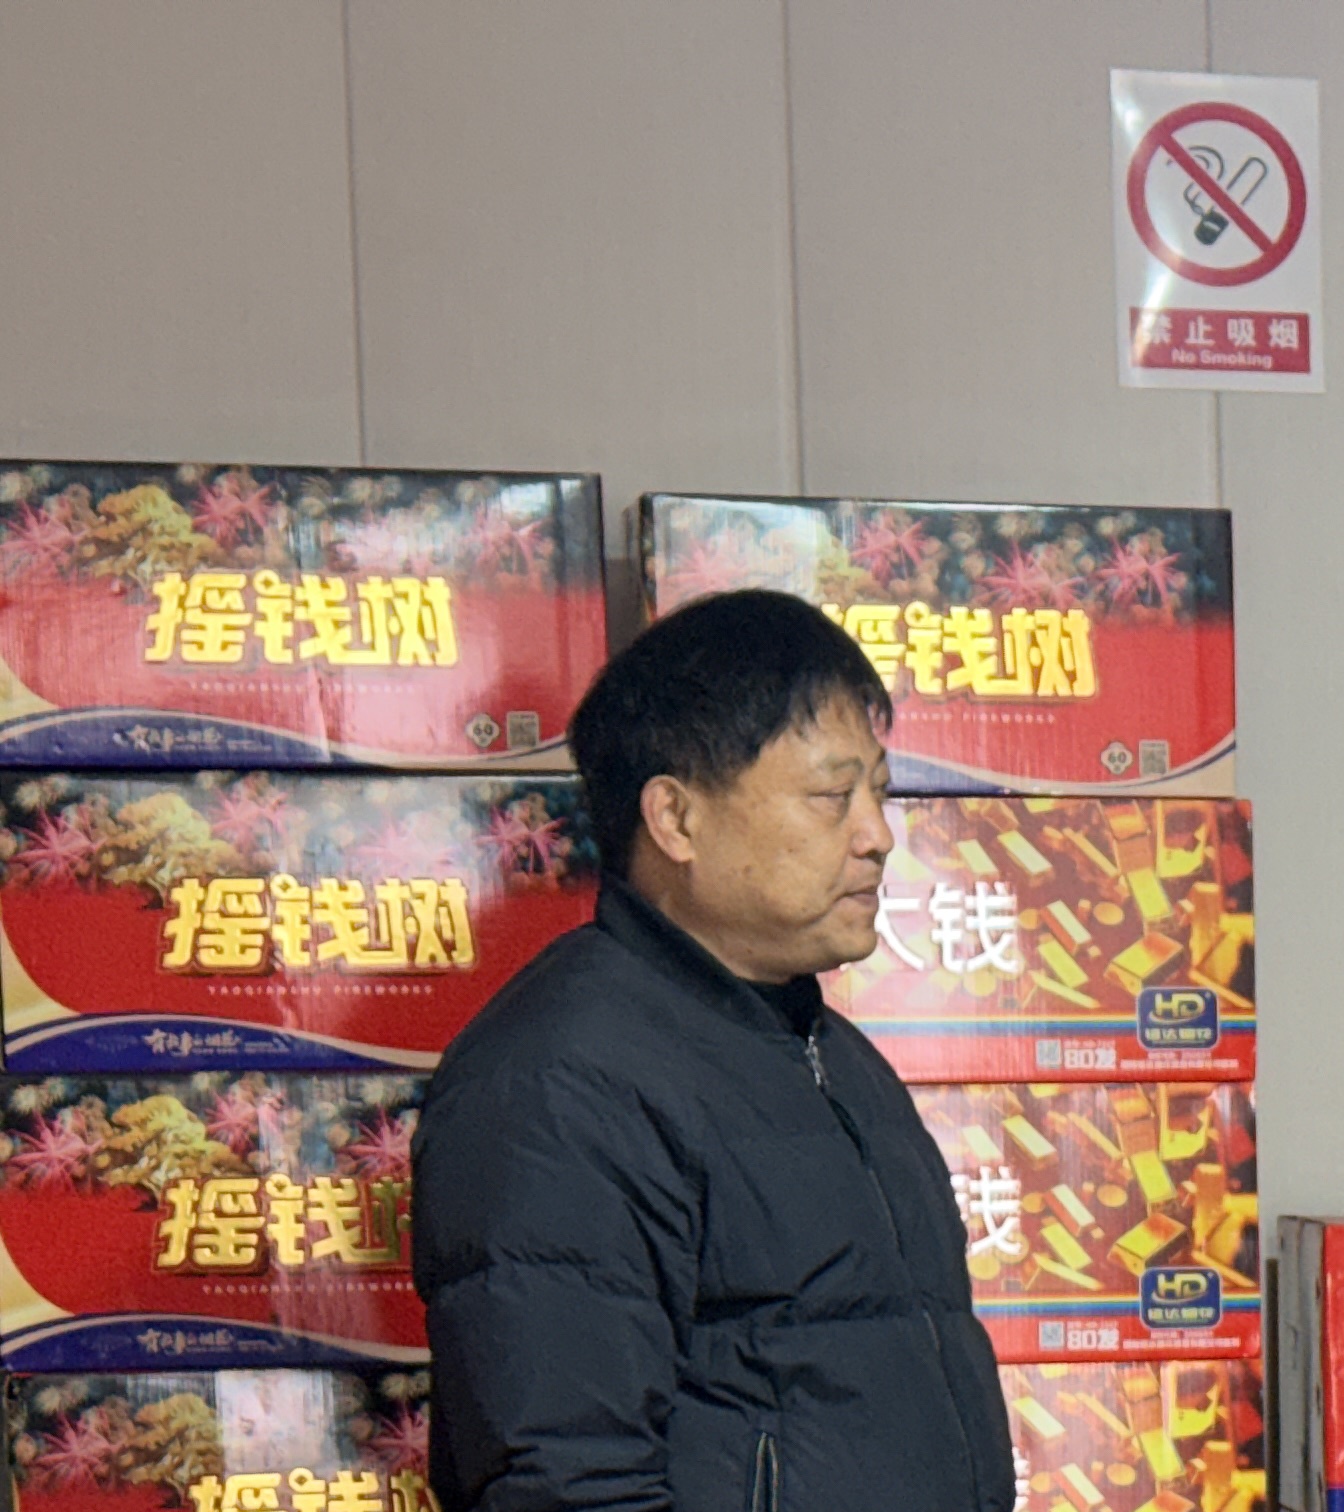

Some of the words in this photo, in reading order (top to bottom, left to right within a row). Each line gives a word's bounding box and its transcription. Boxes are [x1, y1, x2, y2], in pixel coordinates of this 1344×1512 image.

[1142, 317, 1300, 348] 禁止吸烟
[1172, 349, 1194, 364] No
[1200, 351, 1273, 369] Smoking
[145, 570, 459, 667] 摇钱树
[162, 874, 477, 972] 摇钱树
[1154, 992, 1206, 1023] HD
[1157, 1271, 1208, 1301] HD
